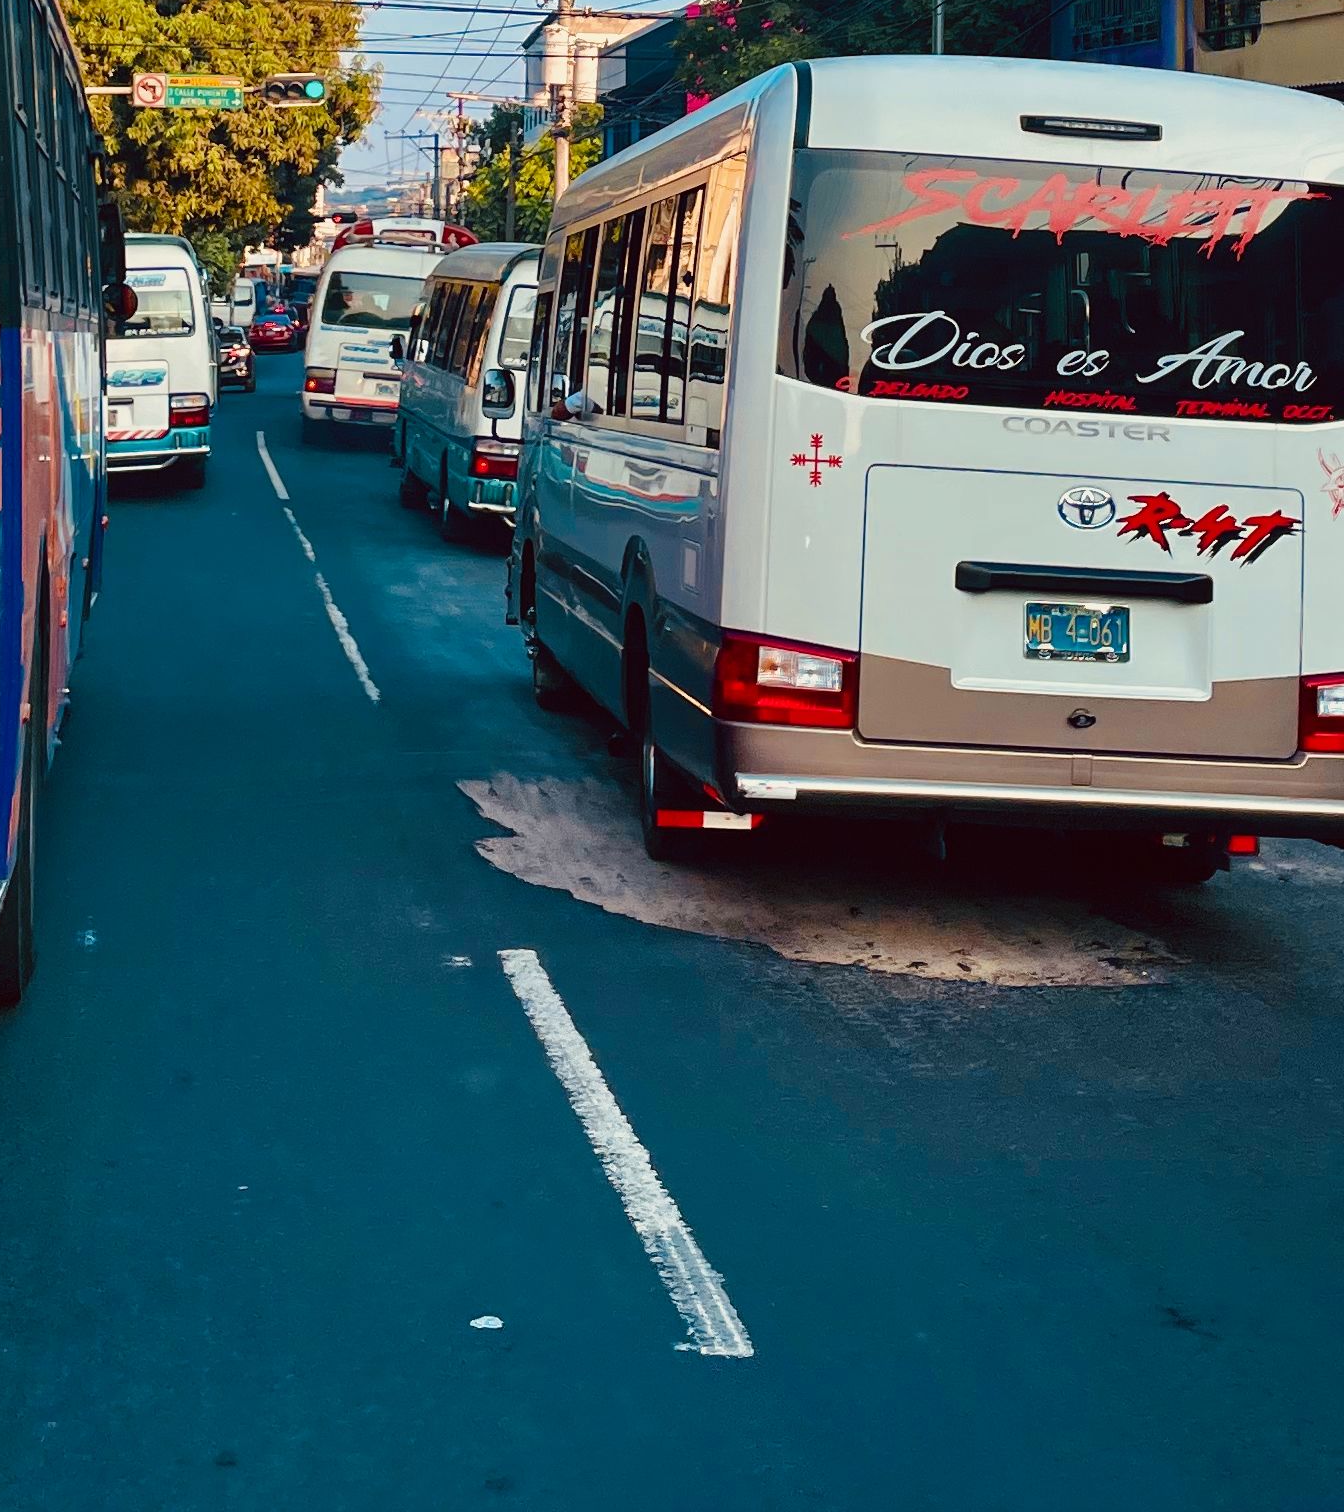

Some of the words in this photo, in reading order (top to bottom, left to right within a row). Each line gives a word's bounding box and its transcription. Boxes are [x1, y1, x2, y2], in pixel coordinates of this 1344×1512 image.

[175, 88, 195, 97] CALLE
[842, 167, 1332, 261] SCARLETT
[861, 310, 1025, 371] Dios
[1056, 345, 1109, 377] es
[1136, 330, 1317, 393] Amor
[869, 380, 969, 400] DELGADO
[1002, 416, 1171, 443] COASTER
